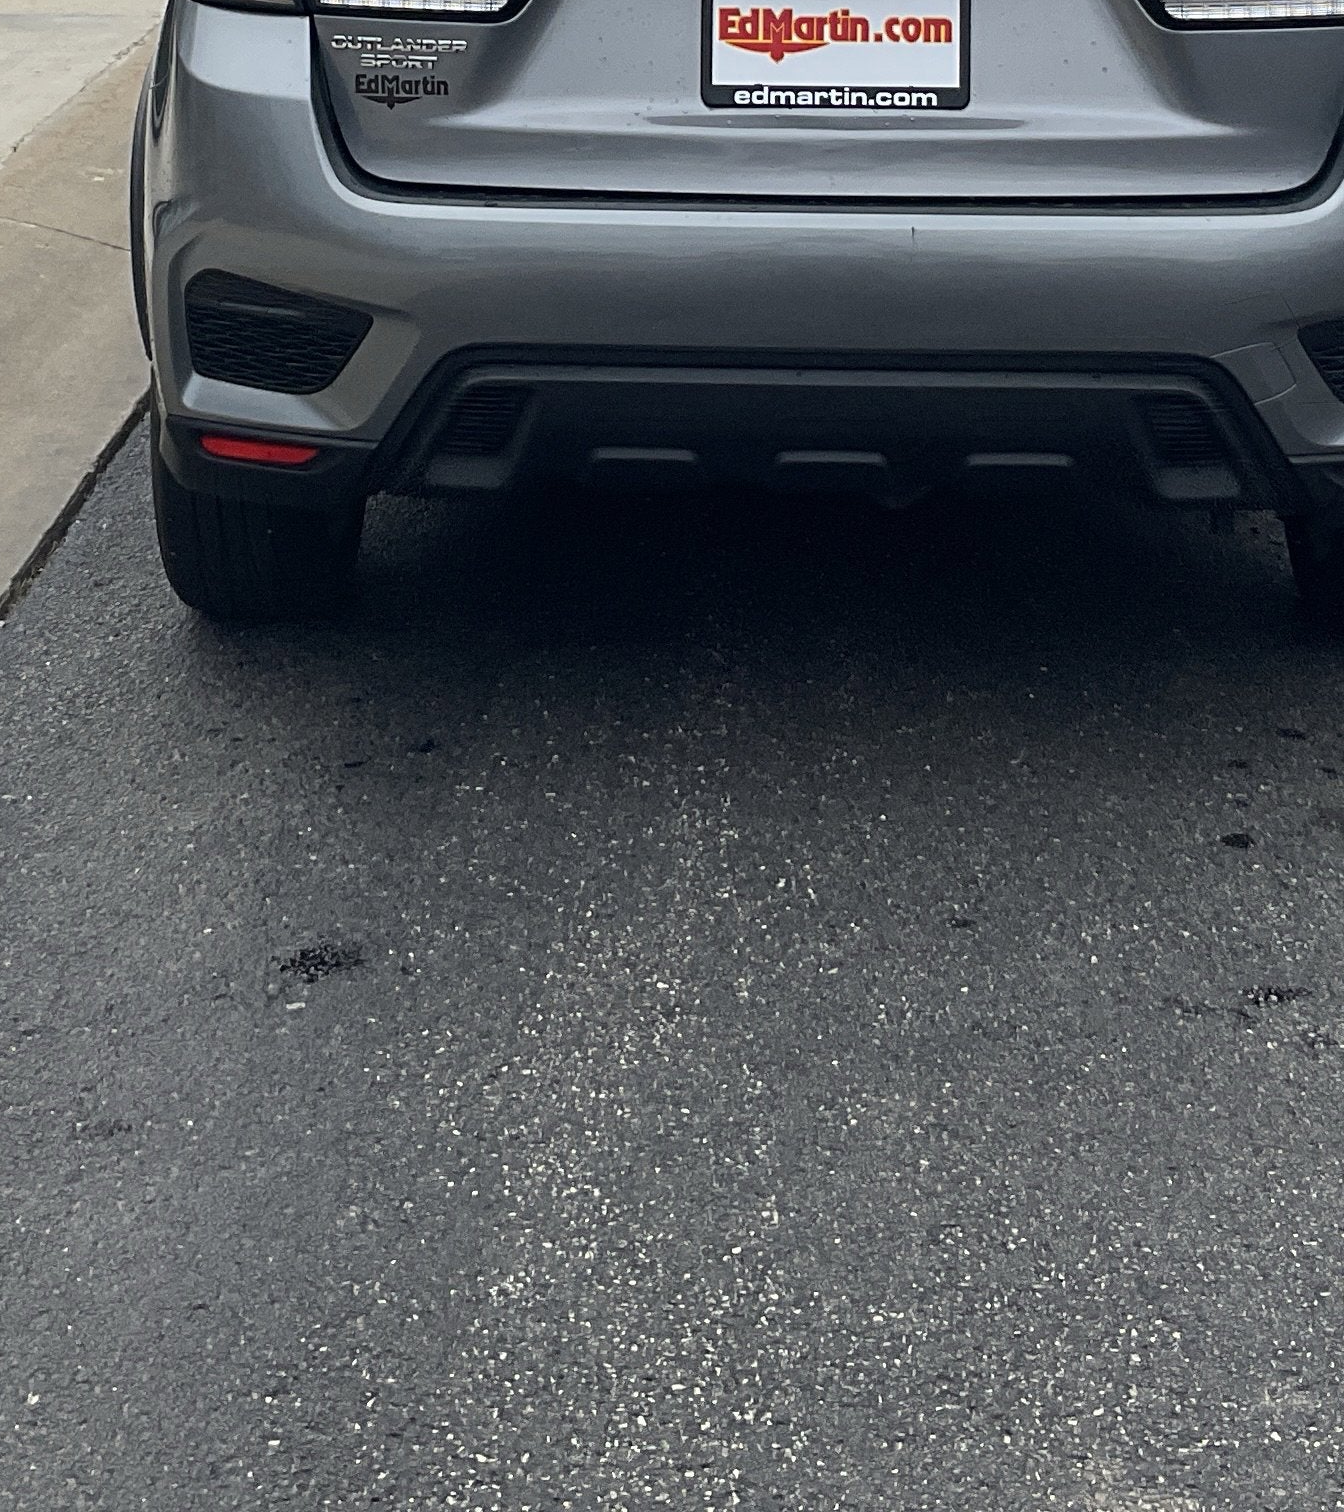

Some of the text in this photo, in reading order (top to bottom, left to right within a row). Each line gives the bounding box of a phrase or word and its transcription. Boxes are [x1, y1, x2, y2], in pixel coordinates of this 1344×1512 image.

[718, 7, 953, 53] EdMartin.com
[330, 34, 468, 53] OUTLANDER
[360, 53, 438, 70] SPORT
[355, 73, 449, 102] EdMartin
[734, 86, 938, 107] edmartin.com
